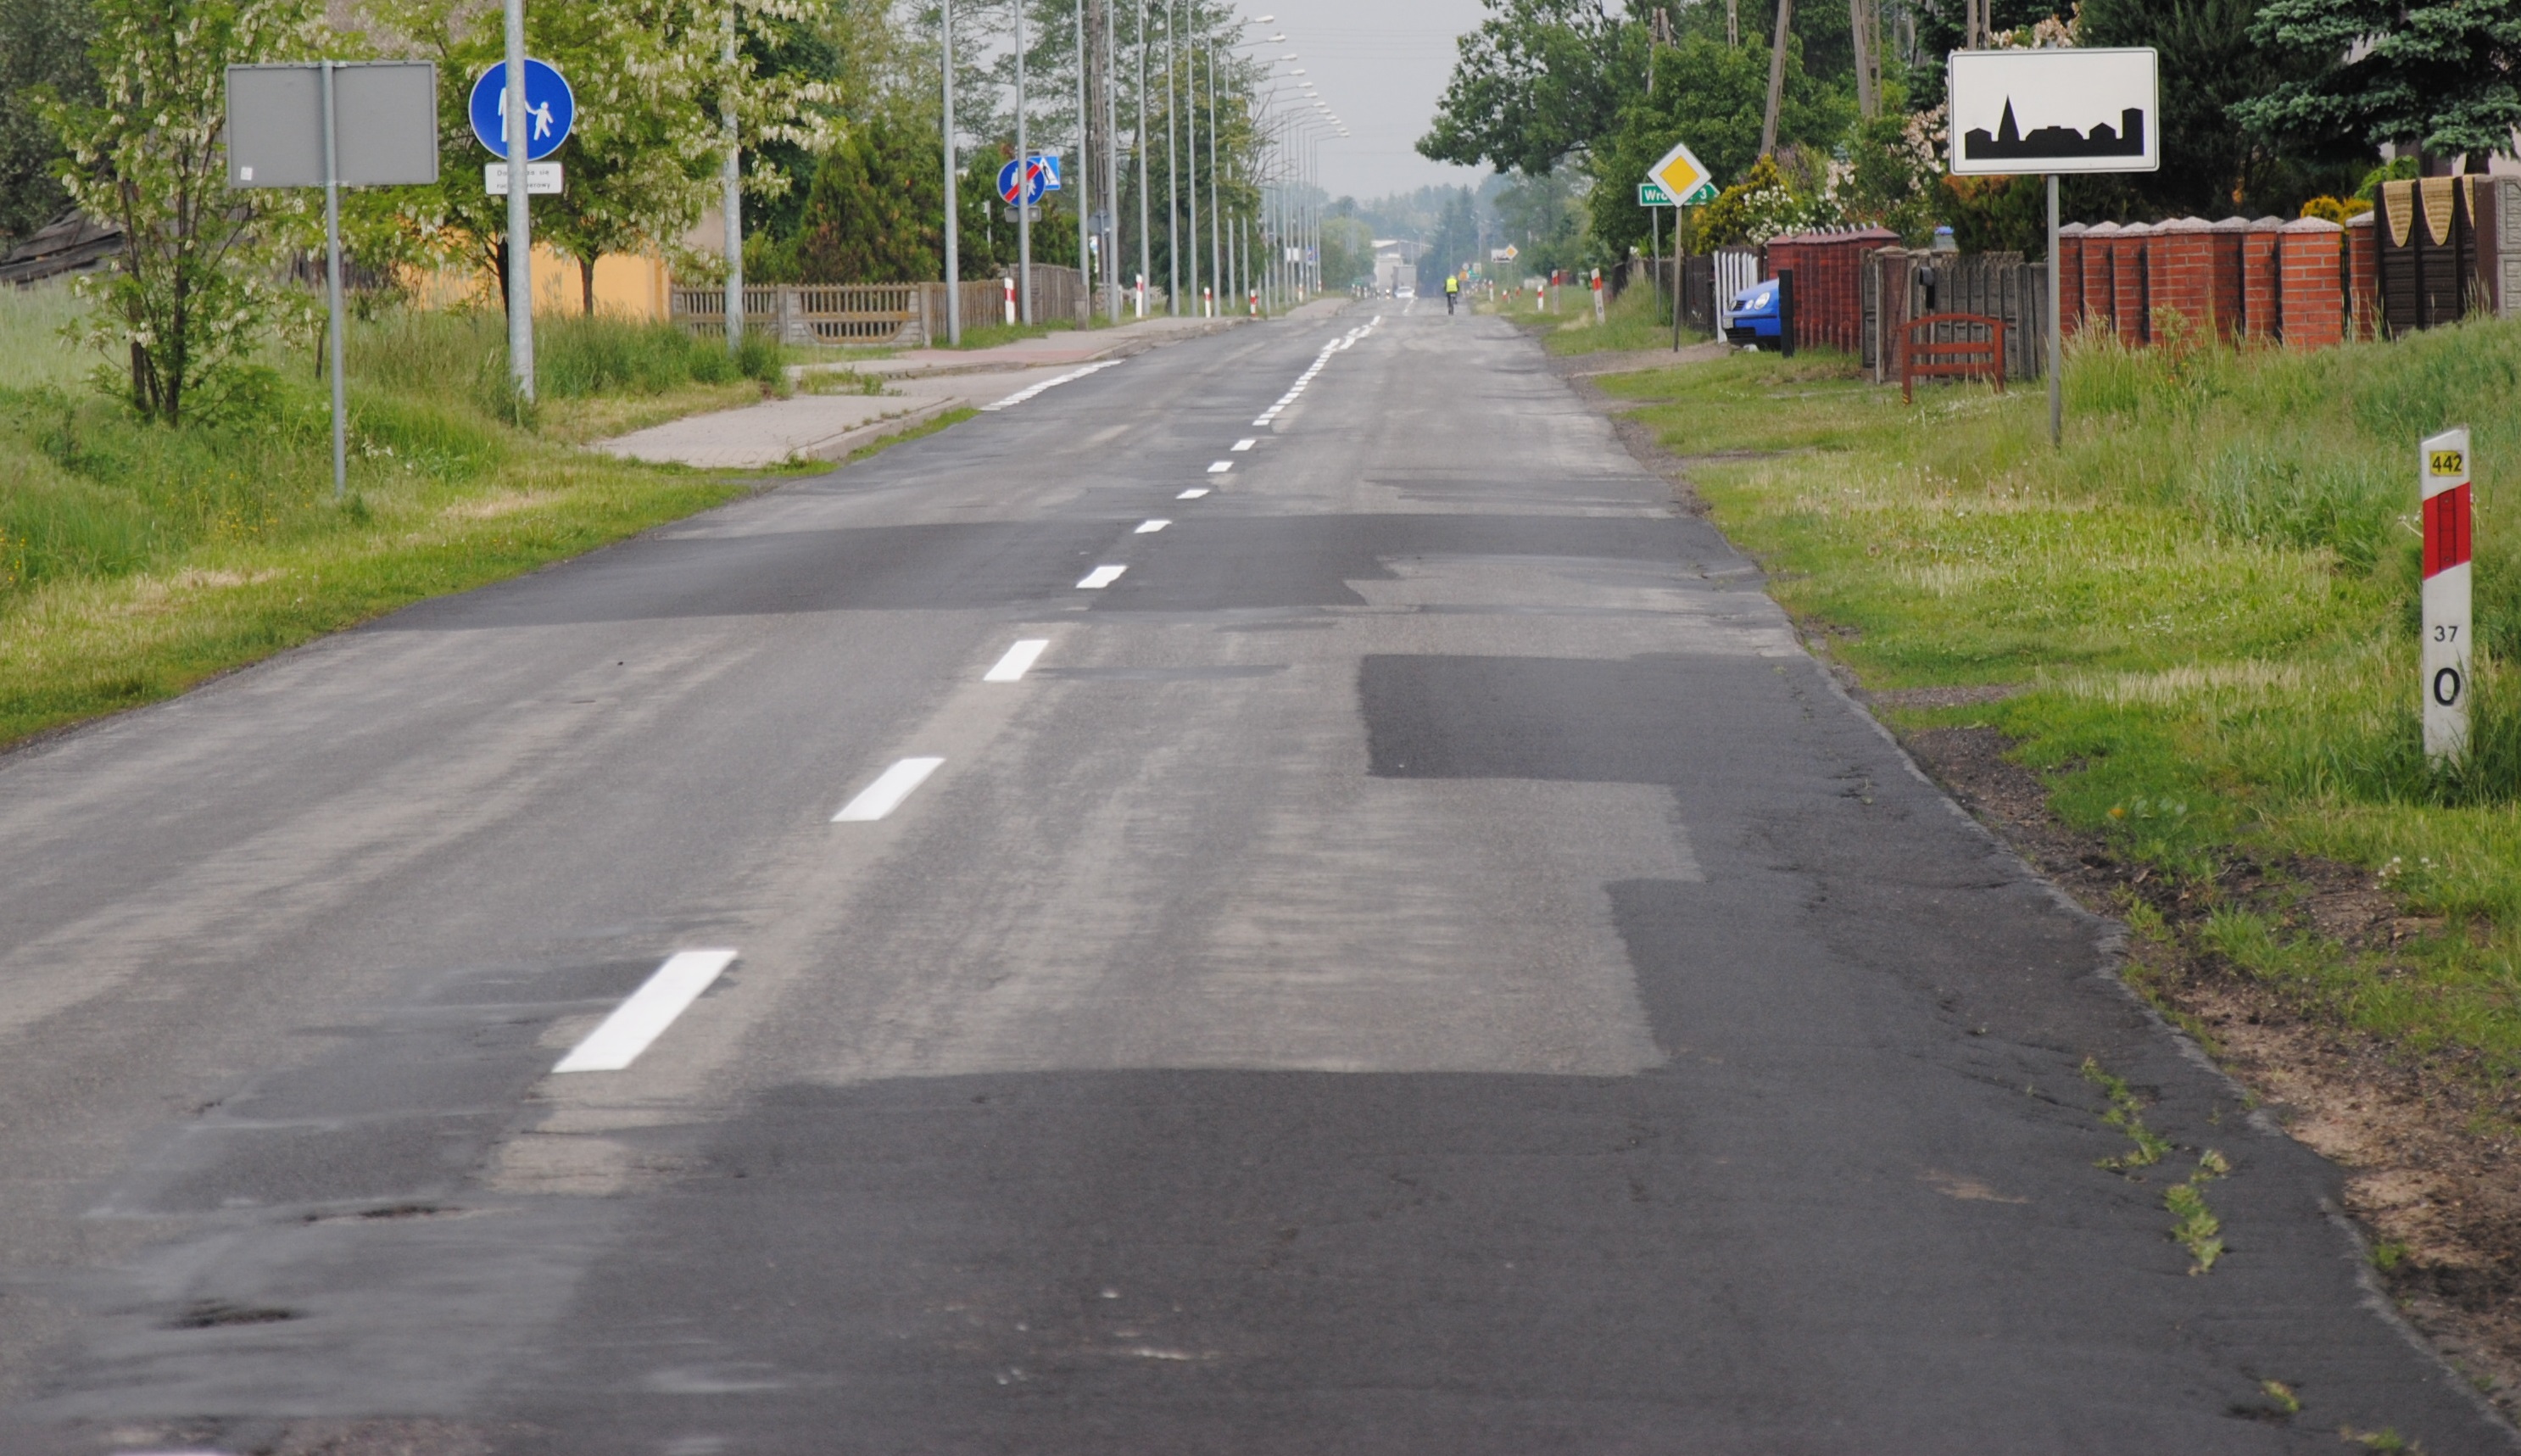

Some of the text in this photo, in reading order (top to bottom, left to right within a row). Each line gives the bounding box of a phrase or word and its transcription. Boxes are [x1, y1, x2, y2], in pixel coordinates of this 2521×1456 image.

[1699, 187, 1708, 200] 3
[2432, 454, 2462, 473] 442
[2434, 625, 2458, 643] 37
[2433, 667, 2461, 707] 0
